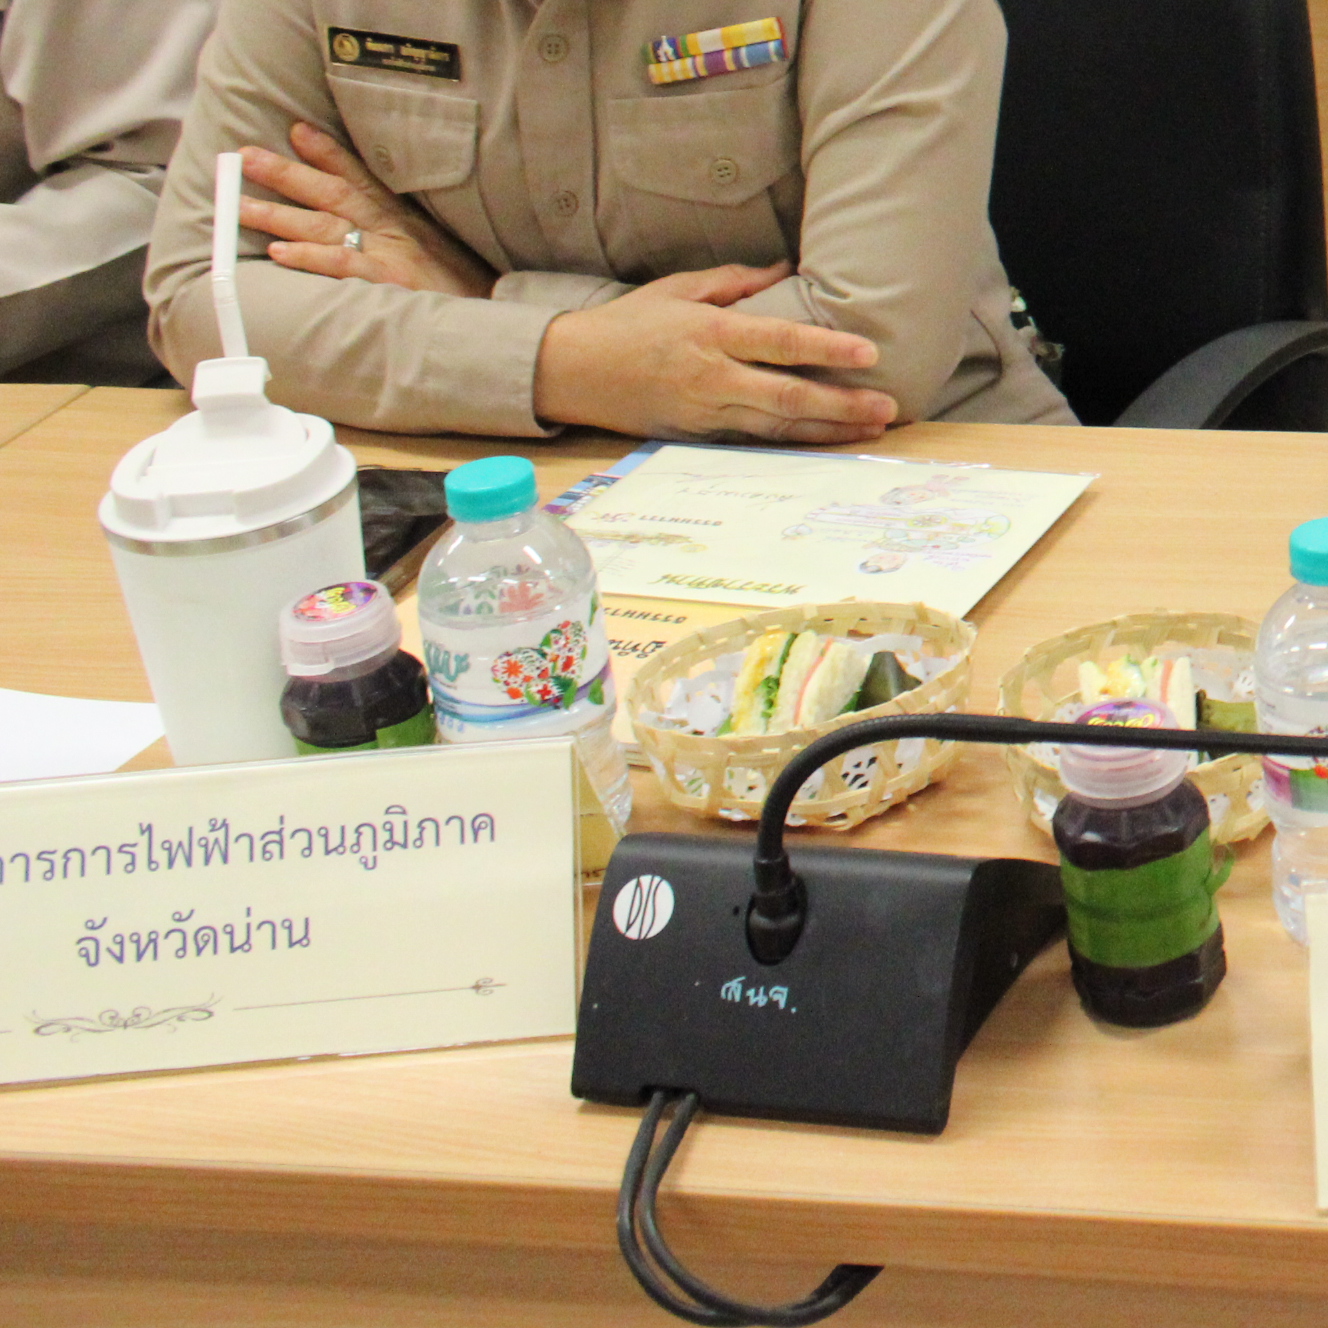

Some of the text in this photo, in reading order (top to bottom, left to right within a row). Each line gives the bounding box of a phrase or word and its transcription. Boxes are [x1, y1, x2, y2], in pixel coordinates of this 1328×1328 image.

[0, 804, 497, 884] ารการไฟฟ้าส่วนภูมิภาค
[76, 906, 312, 968] จังหวัดน่าน
